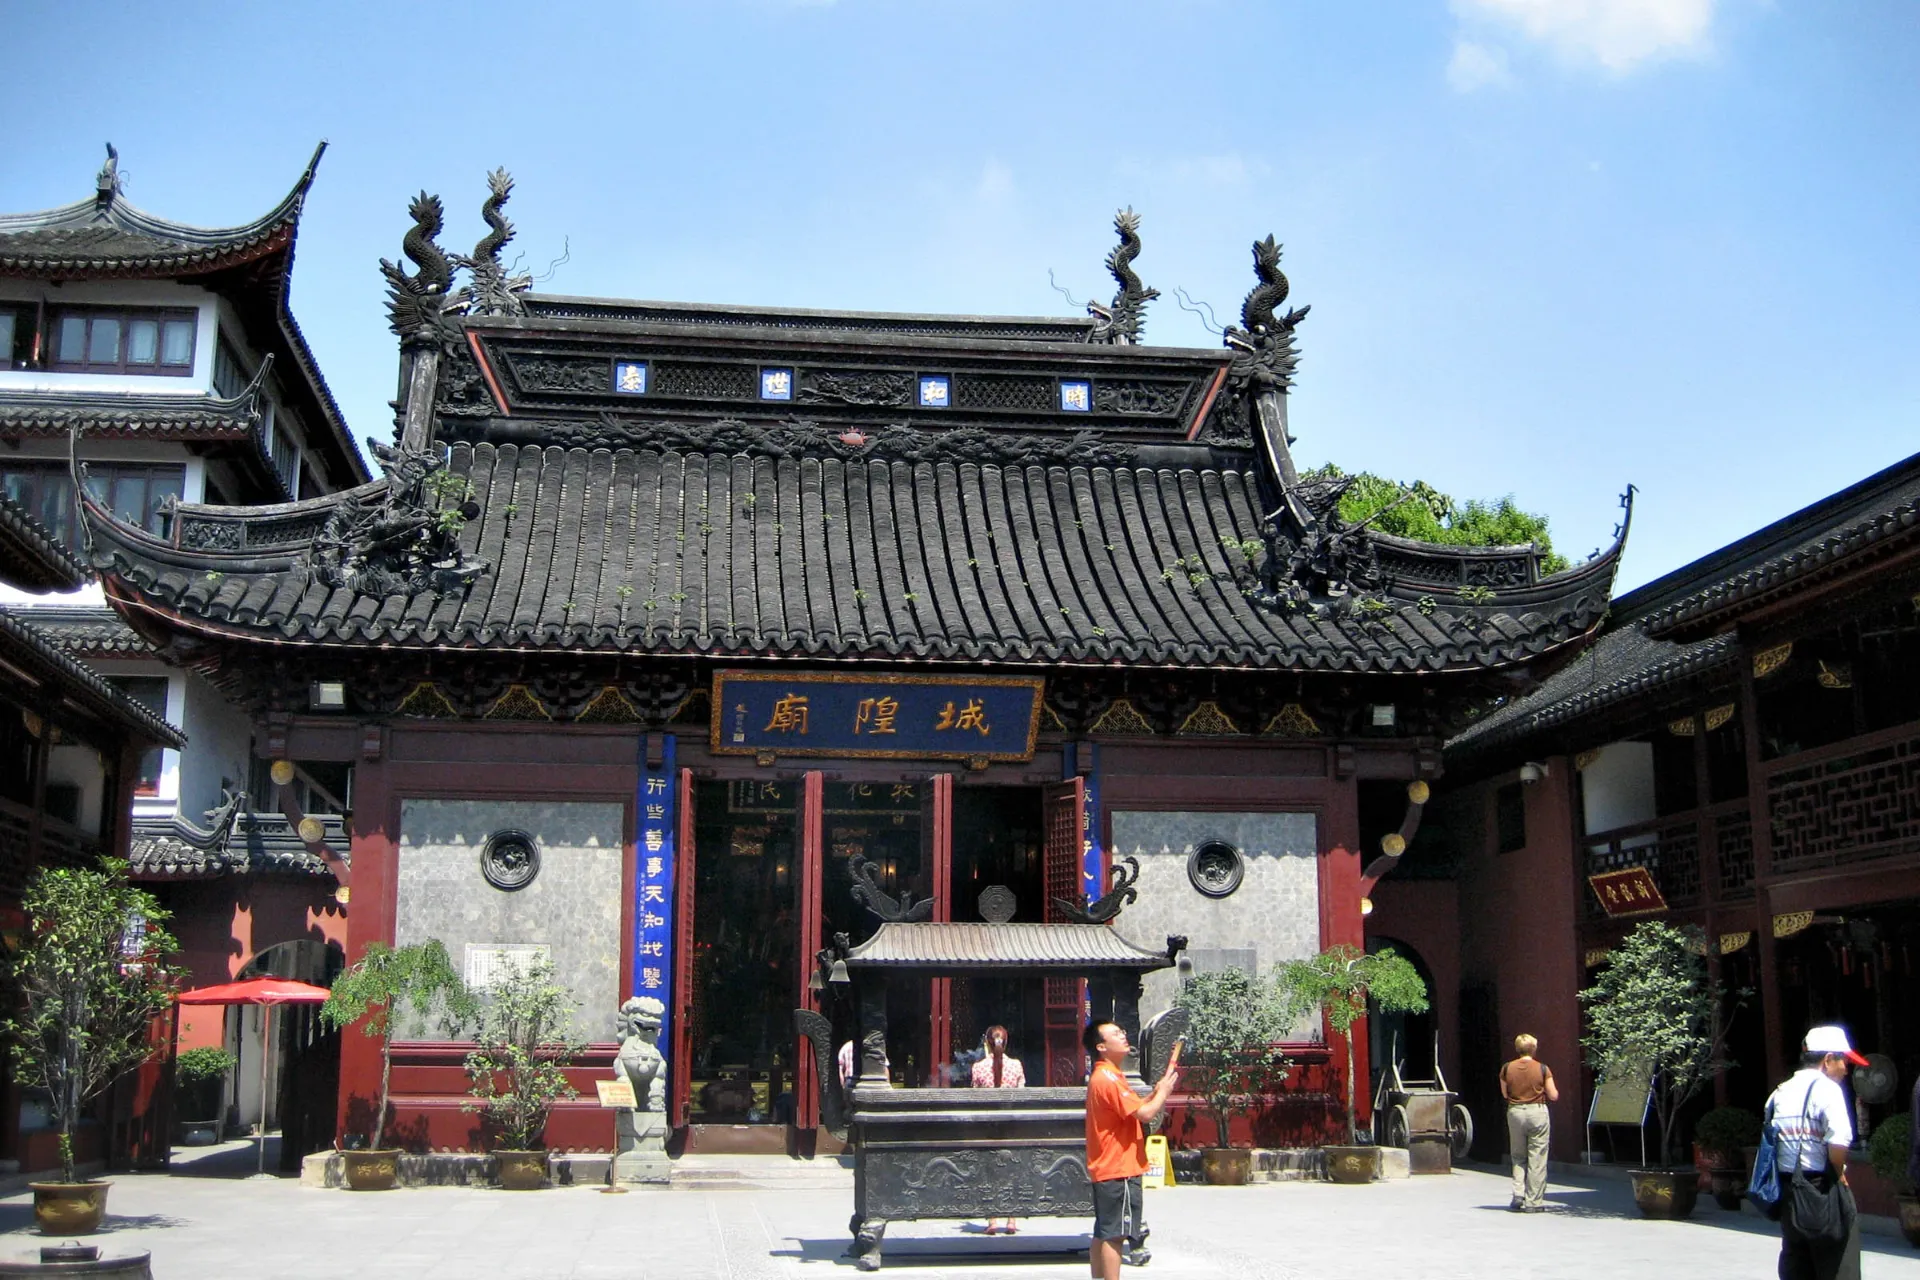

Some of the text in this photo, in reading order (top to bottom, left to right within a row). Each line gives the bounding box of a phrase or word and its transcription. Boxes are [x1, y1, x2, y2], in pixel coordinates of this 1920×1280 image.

[618, 365, 1086, 409] 時 和 世 泰
[764, 692, 990, 736] 城隍廟
